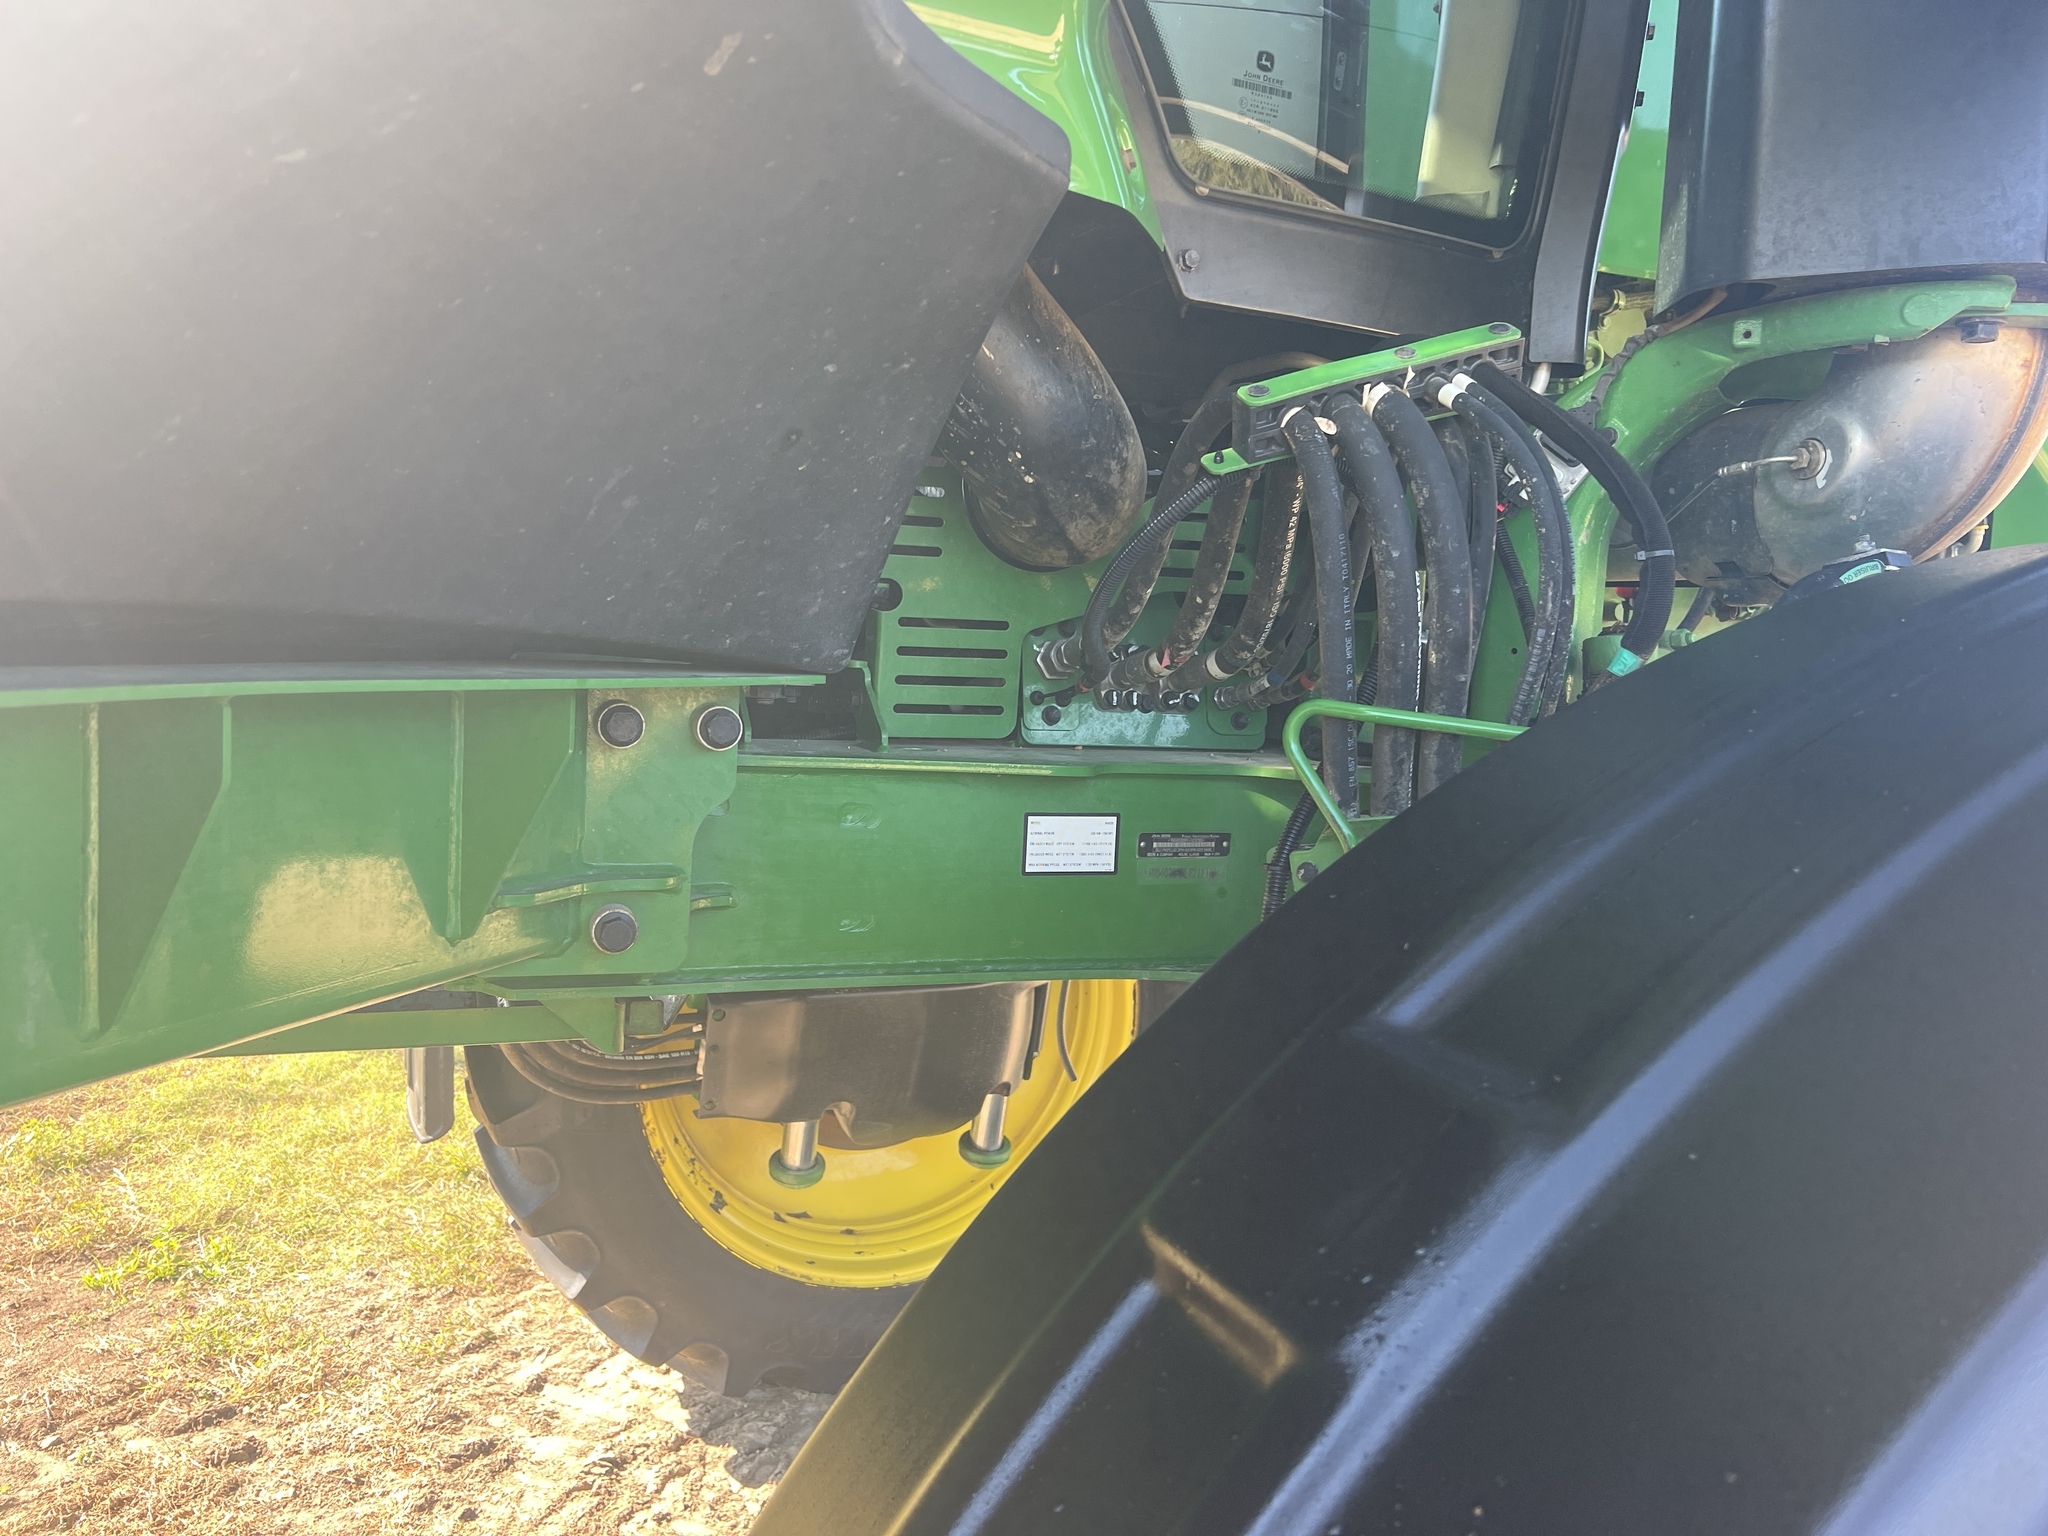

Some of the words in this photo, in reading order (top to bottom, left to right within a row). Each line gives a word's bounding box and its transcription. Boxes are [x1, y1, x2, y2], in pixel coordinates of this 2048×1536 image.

[1342, 587, 1353, 617] ITALY
[1344, 619, 1352, 631] IN
[1345, 637, 1353, 660] MADE
[1346, 663, 1354, 675] 20
